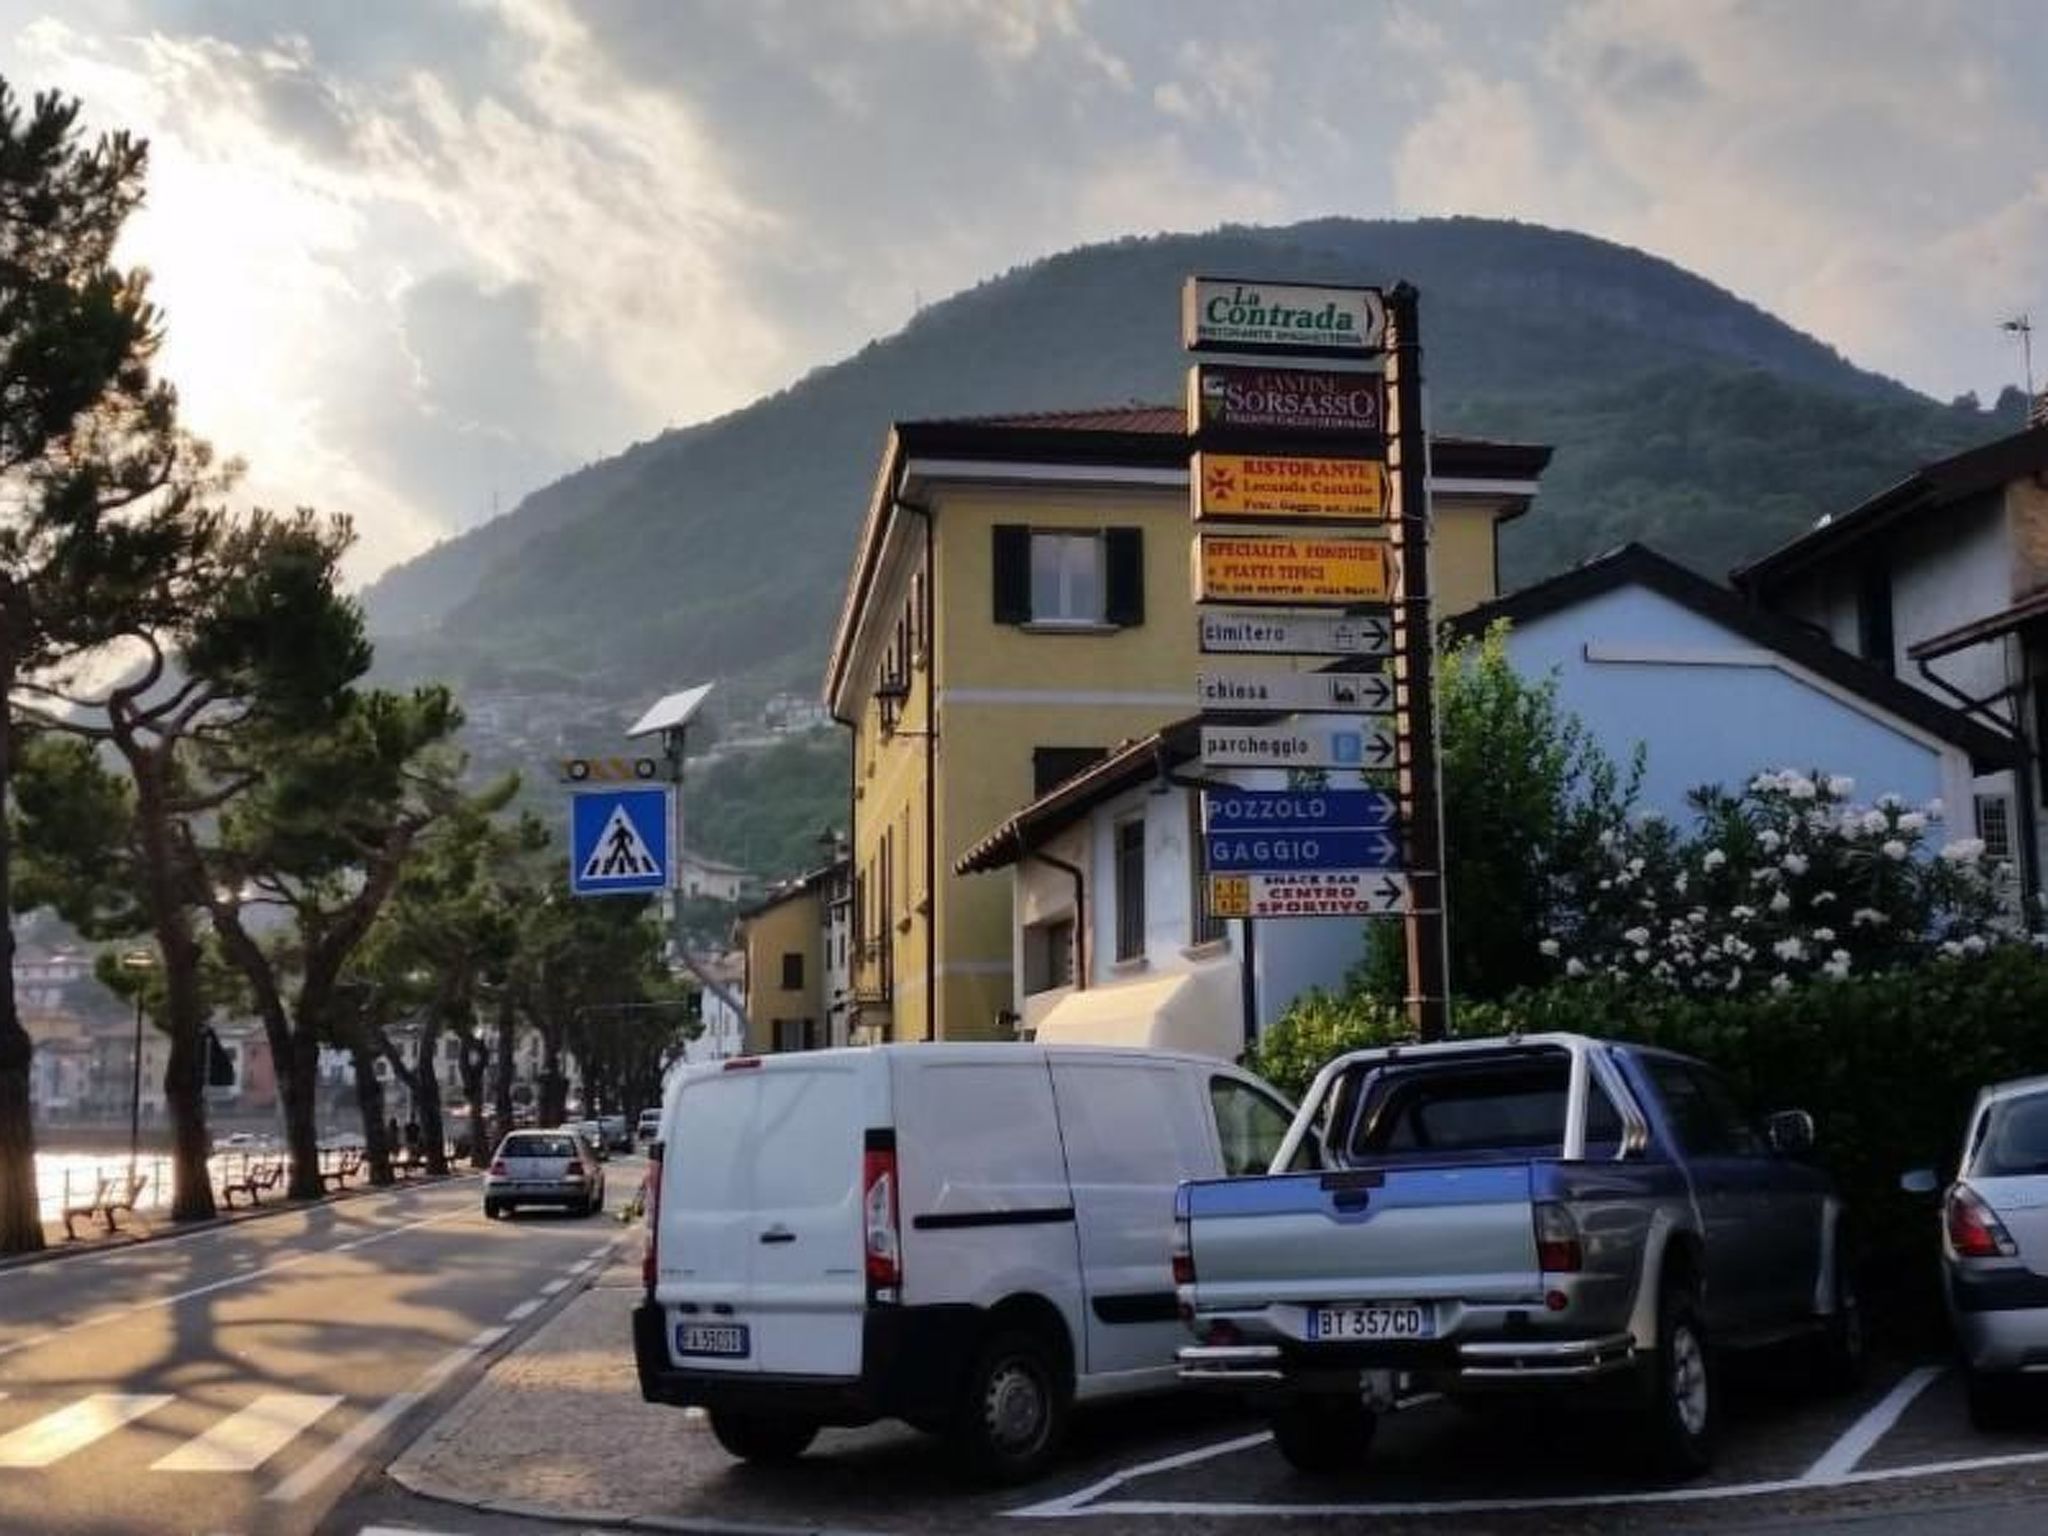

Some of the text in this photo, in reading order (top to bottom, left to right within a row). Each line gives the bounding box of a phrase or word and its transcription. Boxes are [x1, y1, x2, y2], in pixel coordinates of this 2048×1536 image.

[1233, 286, 1260, 306] La
[1207, 296, 1355, 331] Contrada
[1225, 383, 1375, 418] SORSASSO
[1243, 460, 1370, 478] RISTORANTE
[1205, 622, 1285, 641] cimitero
[1206, 680, 1268, 699] chiesa
[1207, 736, 1308, 757] parcheggio
[1207, 798, 1327, 819] POZZOLO
[1213, 840, 1320, 861] GAGGIO
[1264, 875, 1320, 885] SNACK
[1269, 887, 1356, 899] CENTRO
[1256, 900, 1370, 913] SPORTIVO
[1321, 1311, 1346, 1334] BT
